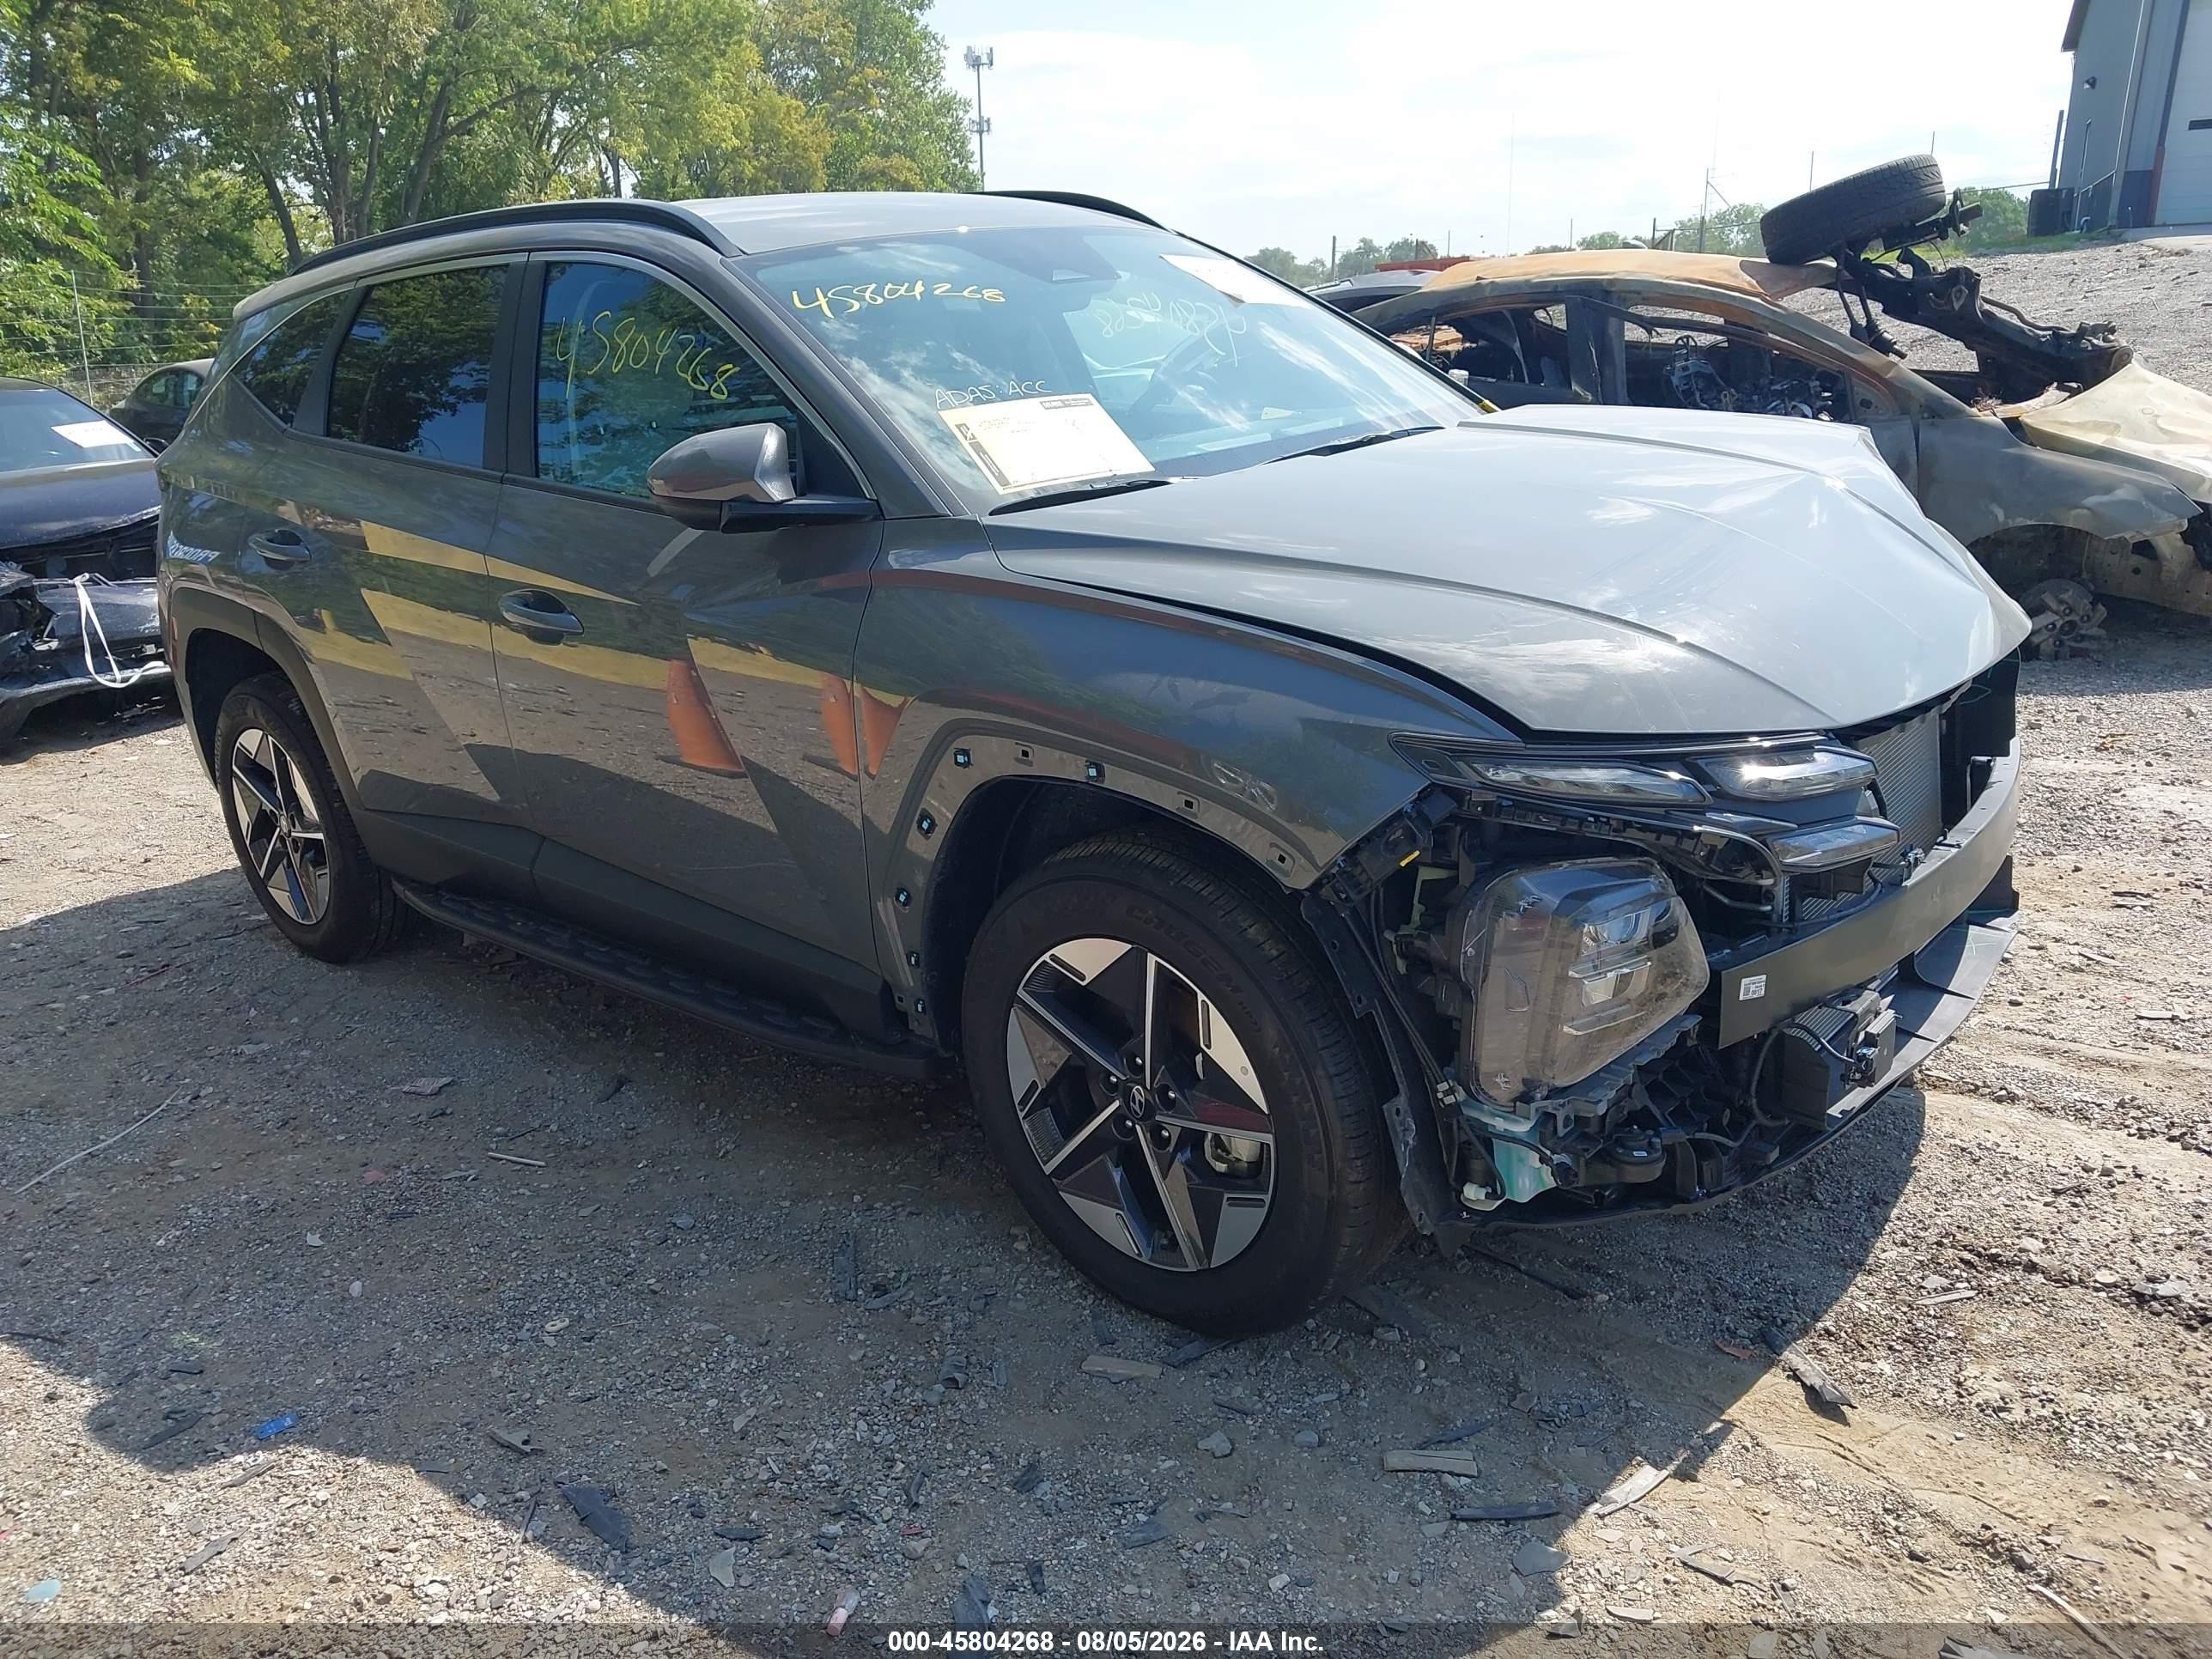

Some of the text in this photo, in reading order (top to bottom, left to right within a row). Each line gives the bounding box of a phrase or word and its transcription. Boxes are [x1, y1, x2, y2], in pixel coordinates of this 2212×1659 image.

[792, 279, 1007, 319] 45804268
[555, 310, 742, 400] 45804268
[1008, 380, 1053, 397] ACC
